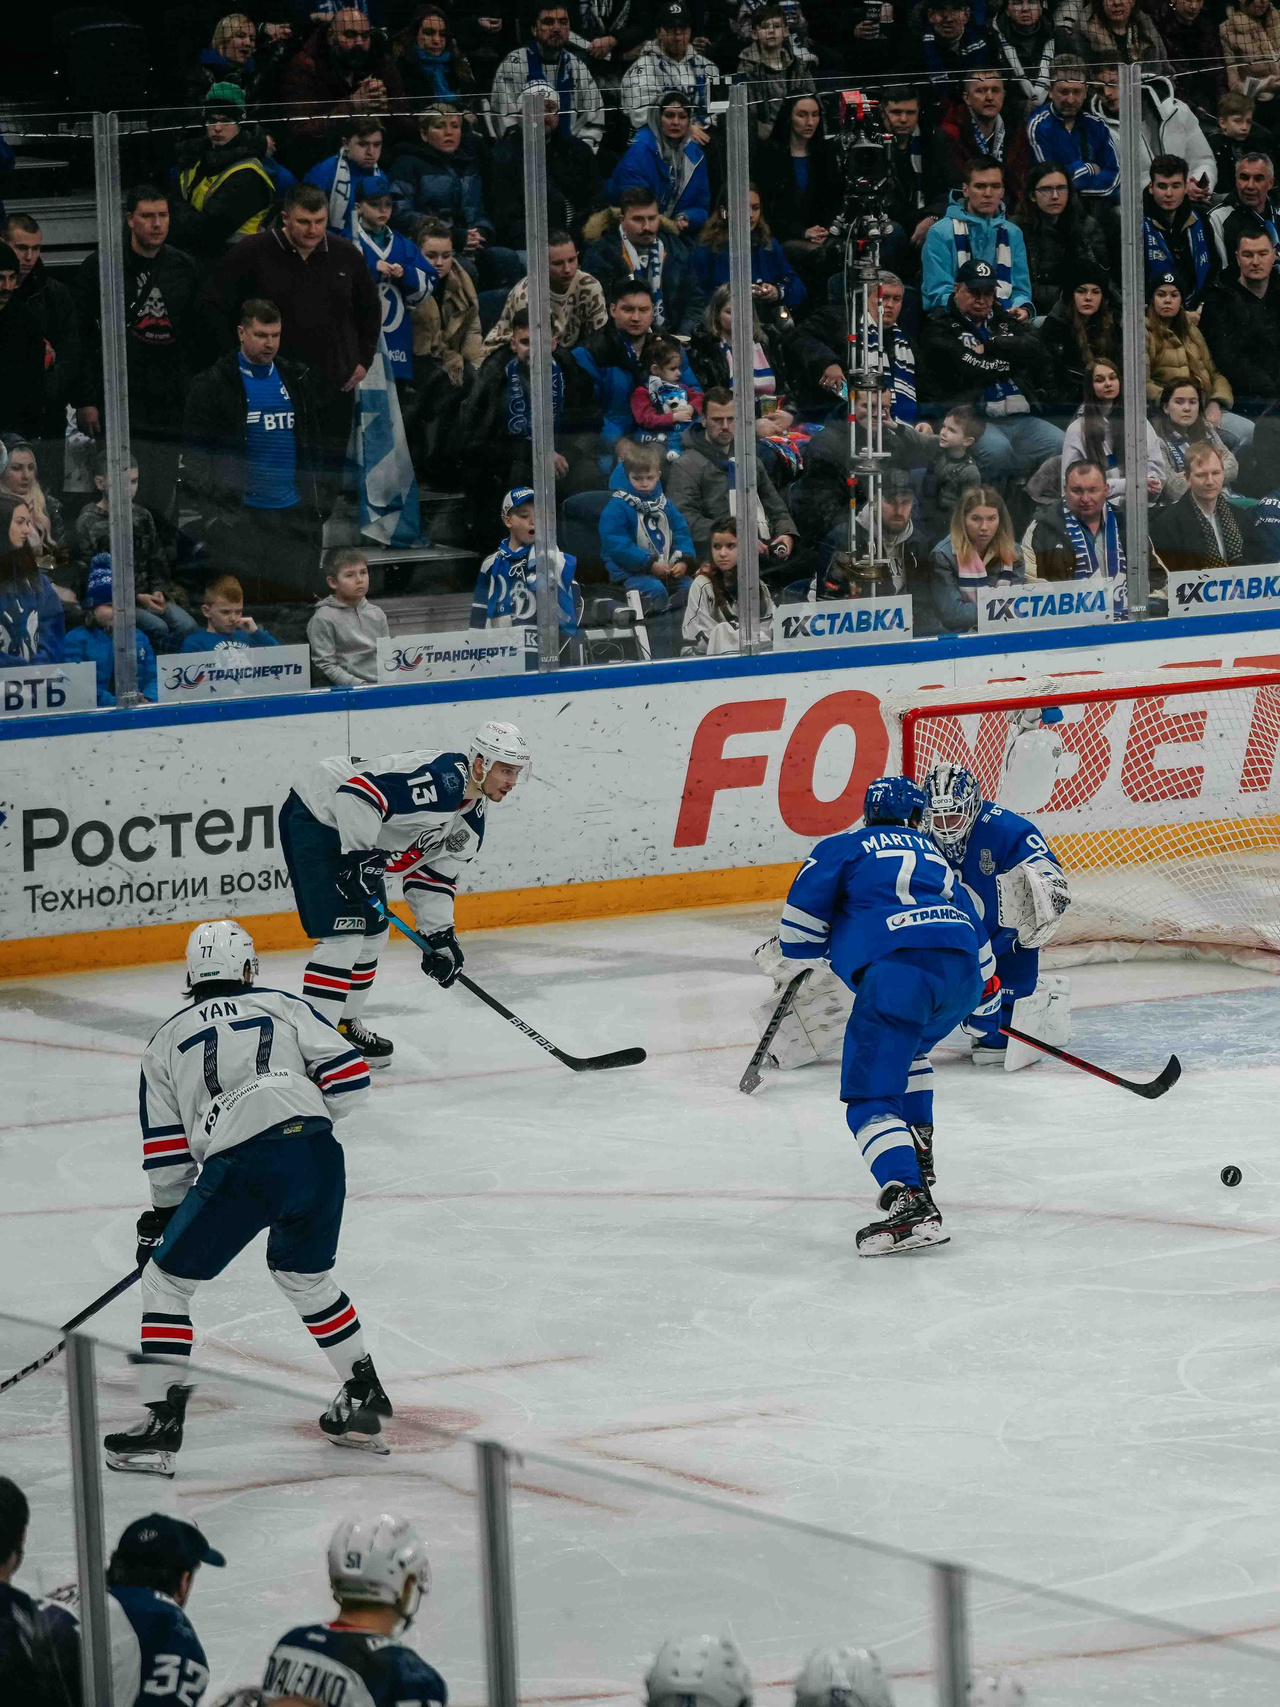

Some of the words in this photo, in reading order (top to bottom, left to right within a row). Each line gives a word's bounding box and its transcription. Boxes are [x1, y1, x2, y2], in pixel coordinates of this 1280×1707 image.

[208, 664, 302, 681] ТРАНСНЕФТЬ
[426, 646, 518, 664] ТРАНСНЕФТЬ
[4, 677, 67, 712] ВТБ
[406, 771, 439, 806] 13
[22, 805, 275, 872] Ростел
[876, 849, 955, 905] 77
[24, 877, 208, 913] Технологии
[201, 945, 212, 958] 77
[199, 1001, 238, 1022] YAN
[177, 1015, 274, 1101] 77
[144, 1654, 209, 1707] 32
